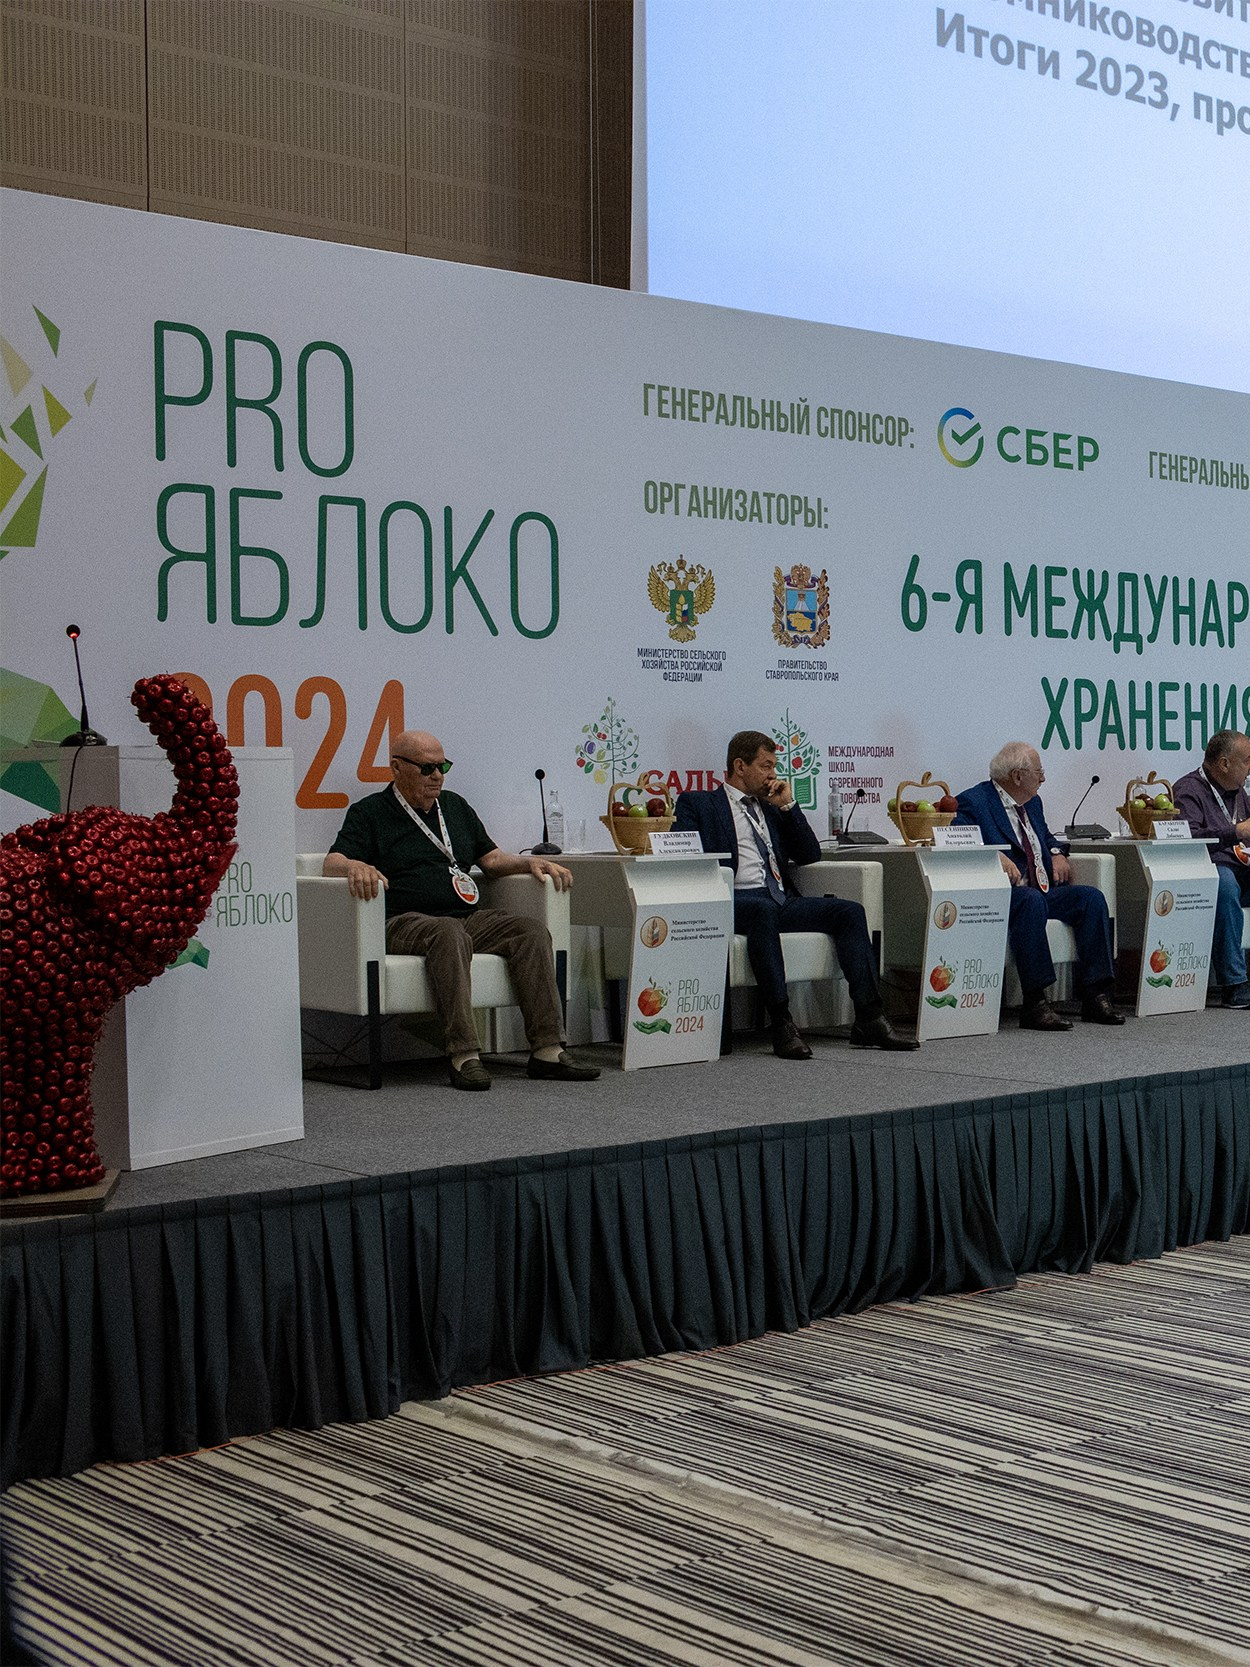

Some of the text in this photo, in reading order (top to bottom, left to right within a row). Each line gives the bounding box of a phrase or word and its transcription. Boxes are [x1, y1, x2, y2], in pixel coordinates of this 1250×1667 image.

[936, 7, 1060, 80] Итоги
[1075, 49, 1181, 122] 2023,
[154, 320, 354, 477] PRO
[643, 383, 915, 449] ГЕНЕРАЛЬНЫЙ СПОНСОР:
[996, 425, 1100, 471] СБЕР
[644, 480, 829, 529] ОРГАНИЗАТОРЫ:
[157, 482, 560, 639] ЯБЛОКО
[901, 555, 983, 635] 6-Я
[637, 648, 726, 661] МИНИСТЕРСТВО СЕЛЬСКОГО
[641, 659, 723, 672] ХОЗЯЙСТВА РОССИЙСКОЙ
[778, 660, 827, 670] ПРАВИТЕЛЬСТВО
[663, 672, 703, 682] ФЕДЕРАЦИИ
[766, 670, 839, 682] СТАВРОПОЛЬСКОГО КРАЯ
[828, 746, 894, 758] МЕЖДУНАРОДНАЯ
[828, 762, 855, 772] ШКОЛА
[217, 862, 253, 893] RO
[216, 892, 293, 927] ЯБЛОКО
[1178, 942, 1194, 956] PRO
[963, 959, 982, 974] PRO
[1177, 956, 1208, 971] ЯБЛОКО
[677, 979, 699, 995] PRO
[962, 973, 999, 990] ЯБЛОКО
[1174, 973, 1195, 988] 2024
[676, 994, 720, 1013] ЯБЛОКО
[960, 993, 985, 1009] 2024
[675, 1016, 704, 1034] 2024
